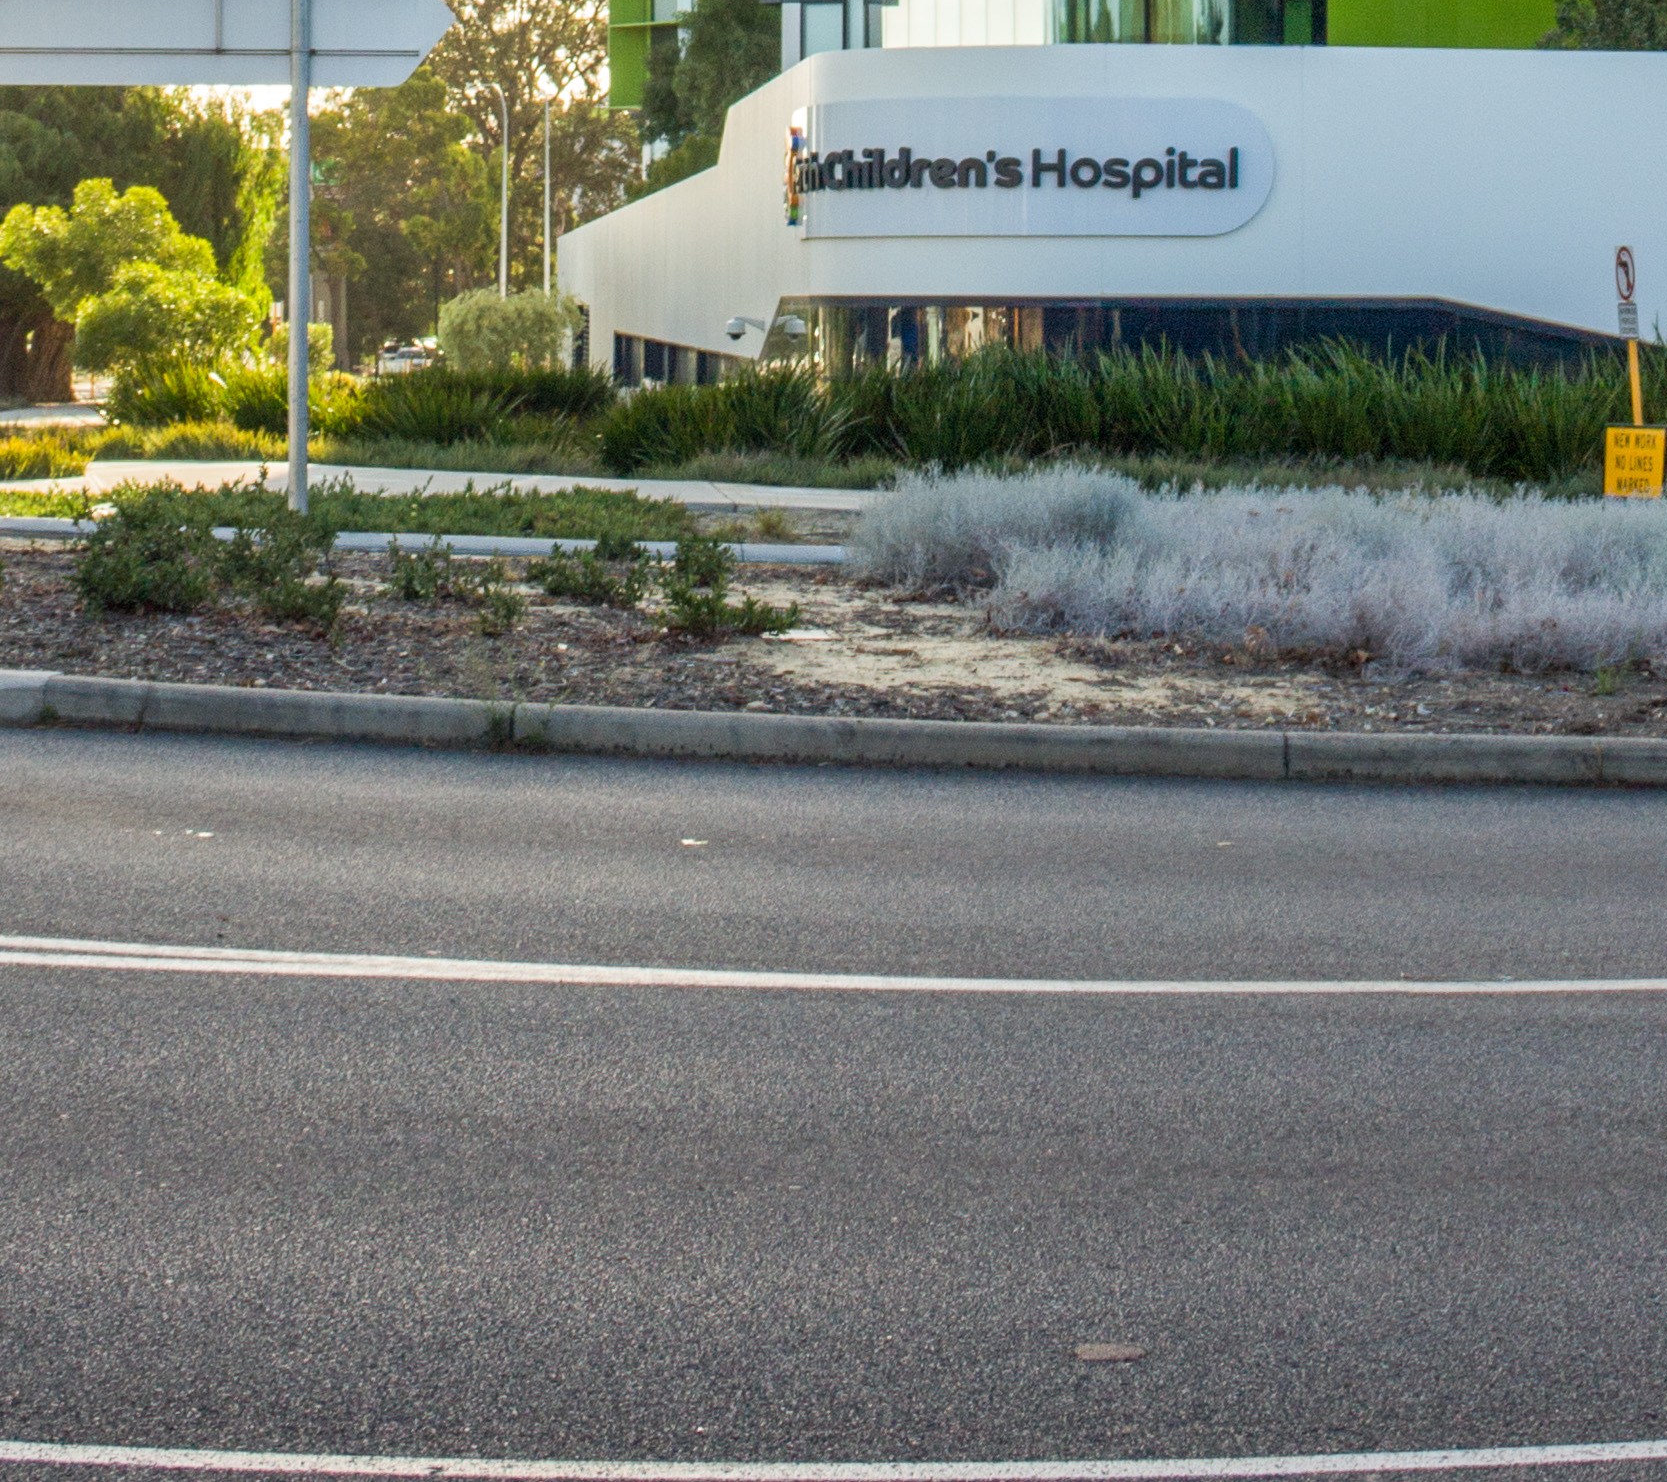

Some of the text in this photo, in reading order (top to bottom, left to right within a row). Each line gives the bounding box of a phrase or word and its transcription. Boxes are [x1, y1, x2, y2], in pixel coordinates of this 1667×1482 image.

[822, 146, 1024, 190] Children's
[1031, 146, 1239, 199] Hospital
[1614, 432, 1657, 449] NEW WORK
[1615, 454, 1654, 472] NO LINES
[1616, 476, 1651, 493] MARKED
